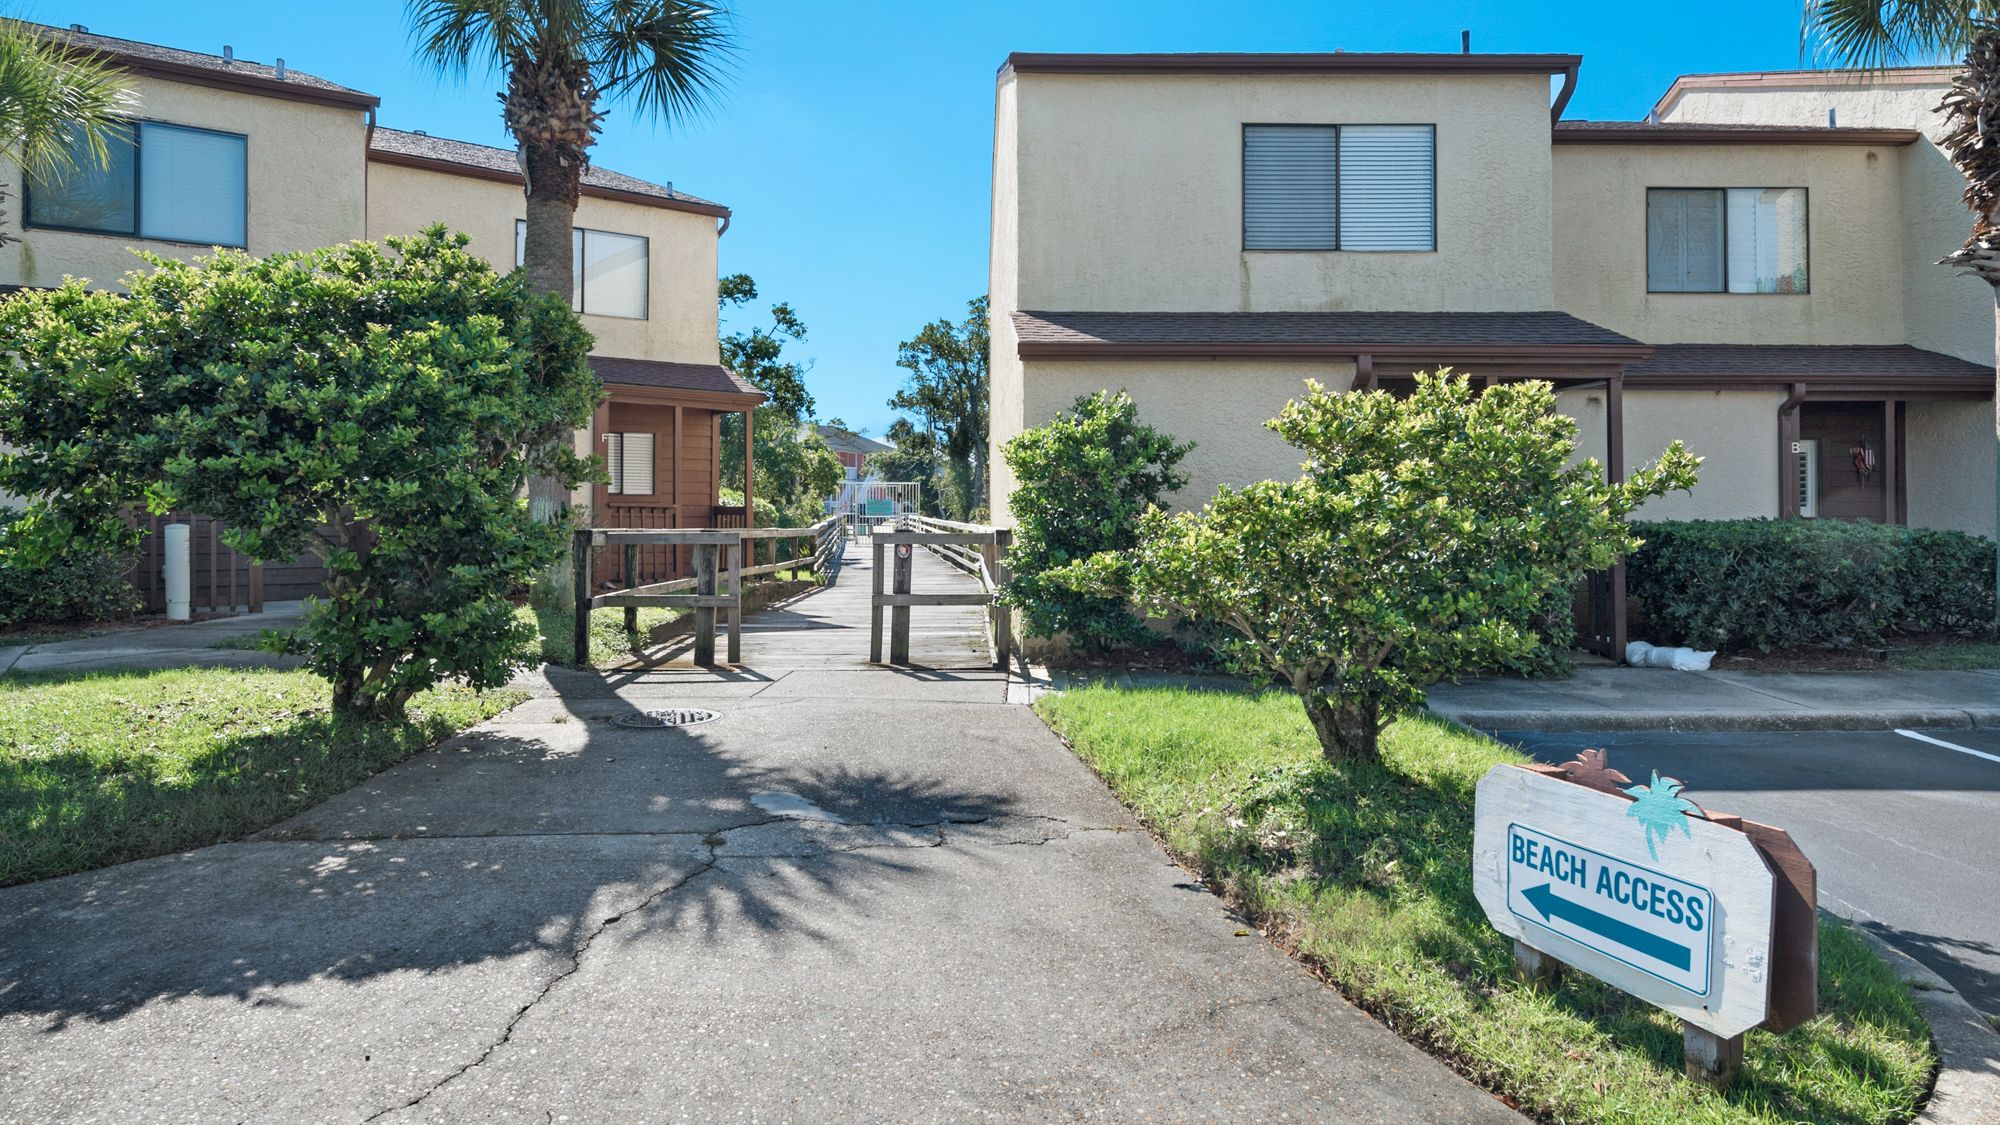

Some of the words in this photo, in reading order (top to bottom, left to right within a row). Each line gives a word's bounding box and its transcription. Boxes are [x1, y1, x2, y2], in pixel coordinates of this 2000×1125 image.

[1791, 442, 1800, 453] B
[1512, 834, 1587, 888] BEACH
[1595, 865, 1704, 931] ACCESS
